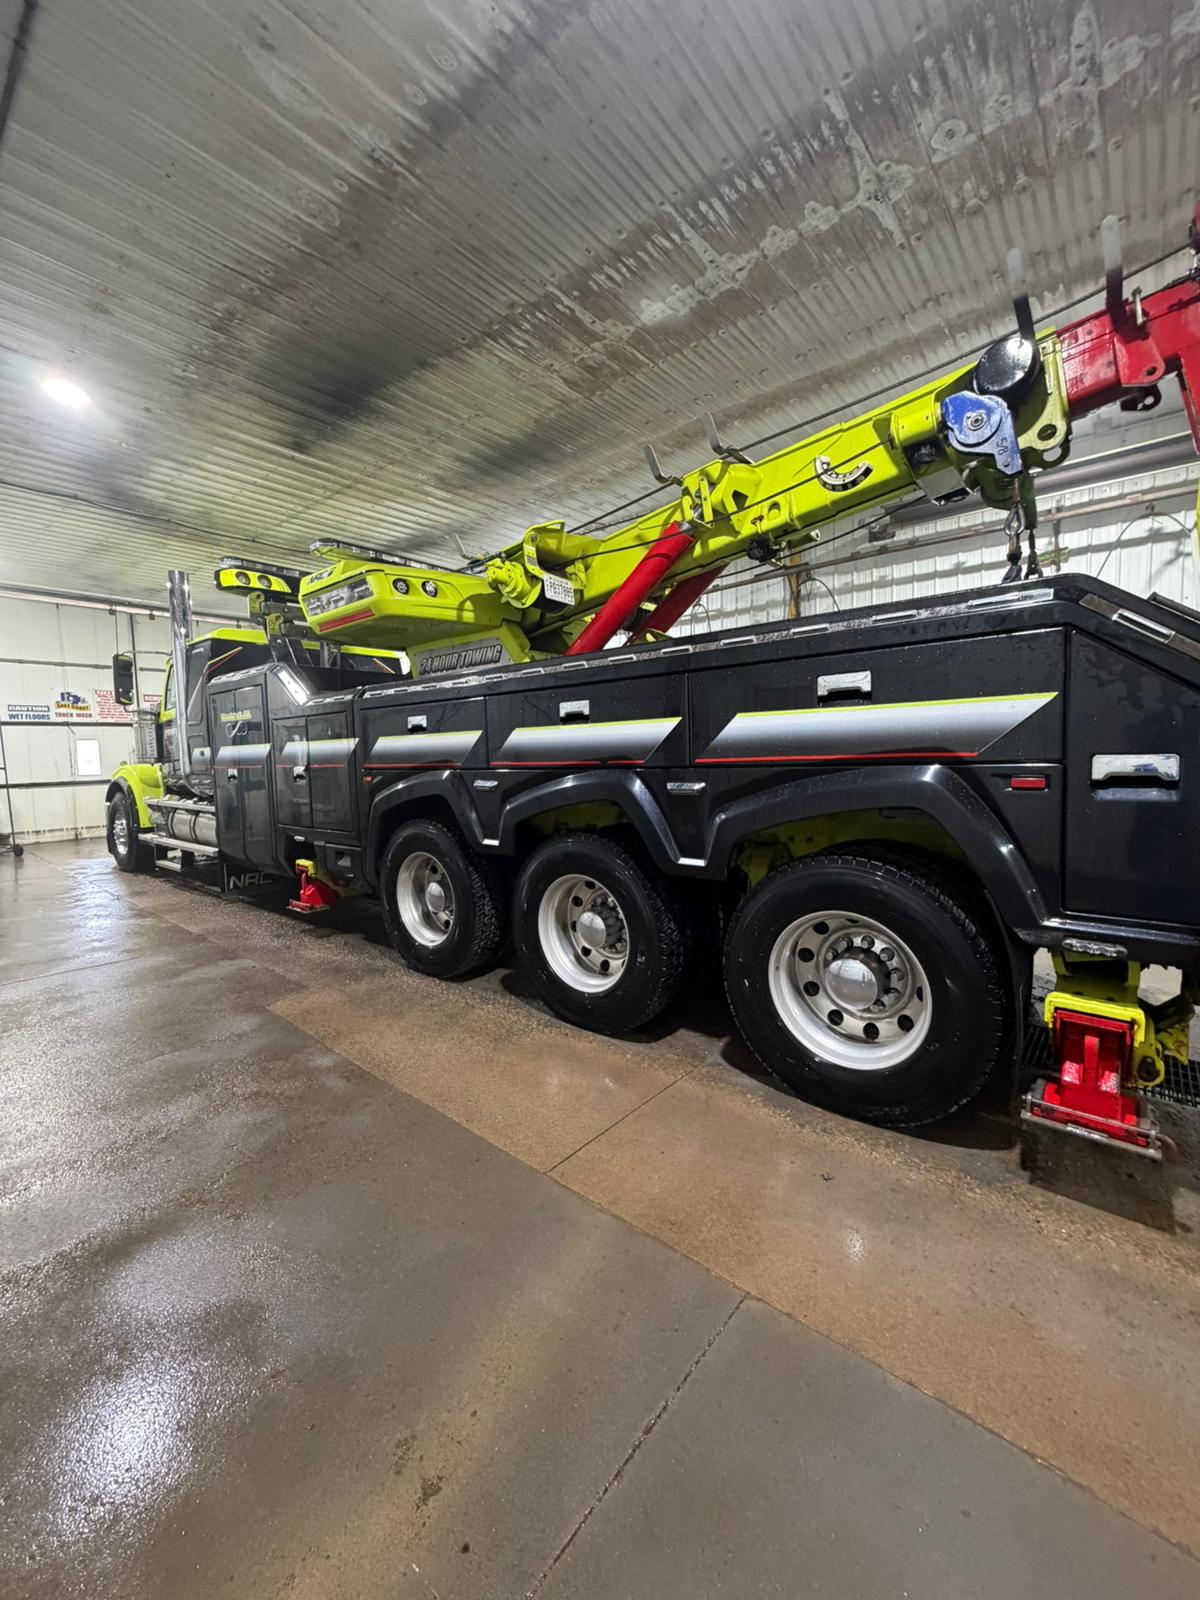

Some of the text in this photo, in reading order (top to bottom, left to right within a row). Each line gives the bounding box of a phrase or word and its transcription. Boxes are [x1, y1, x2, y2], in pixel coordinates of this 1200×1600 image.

[996, 437, 1009, 456] 5/8
[419, 644, 502, 675] 24 HOUR TOWING
